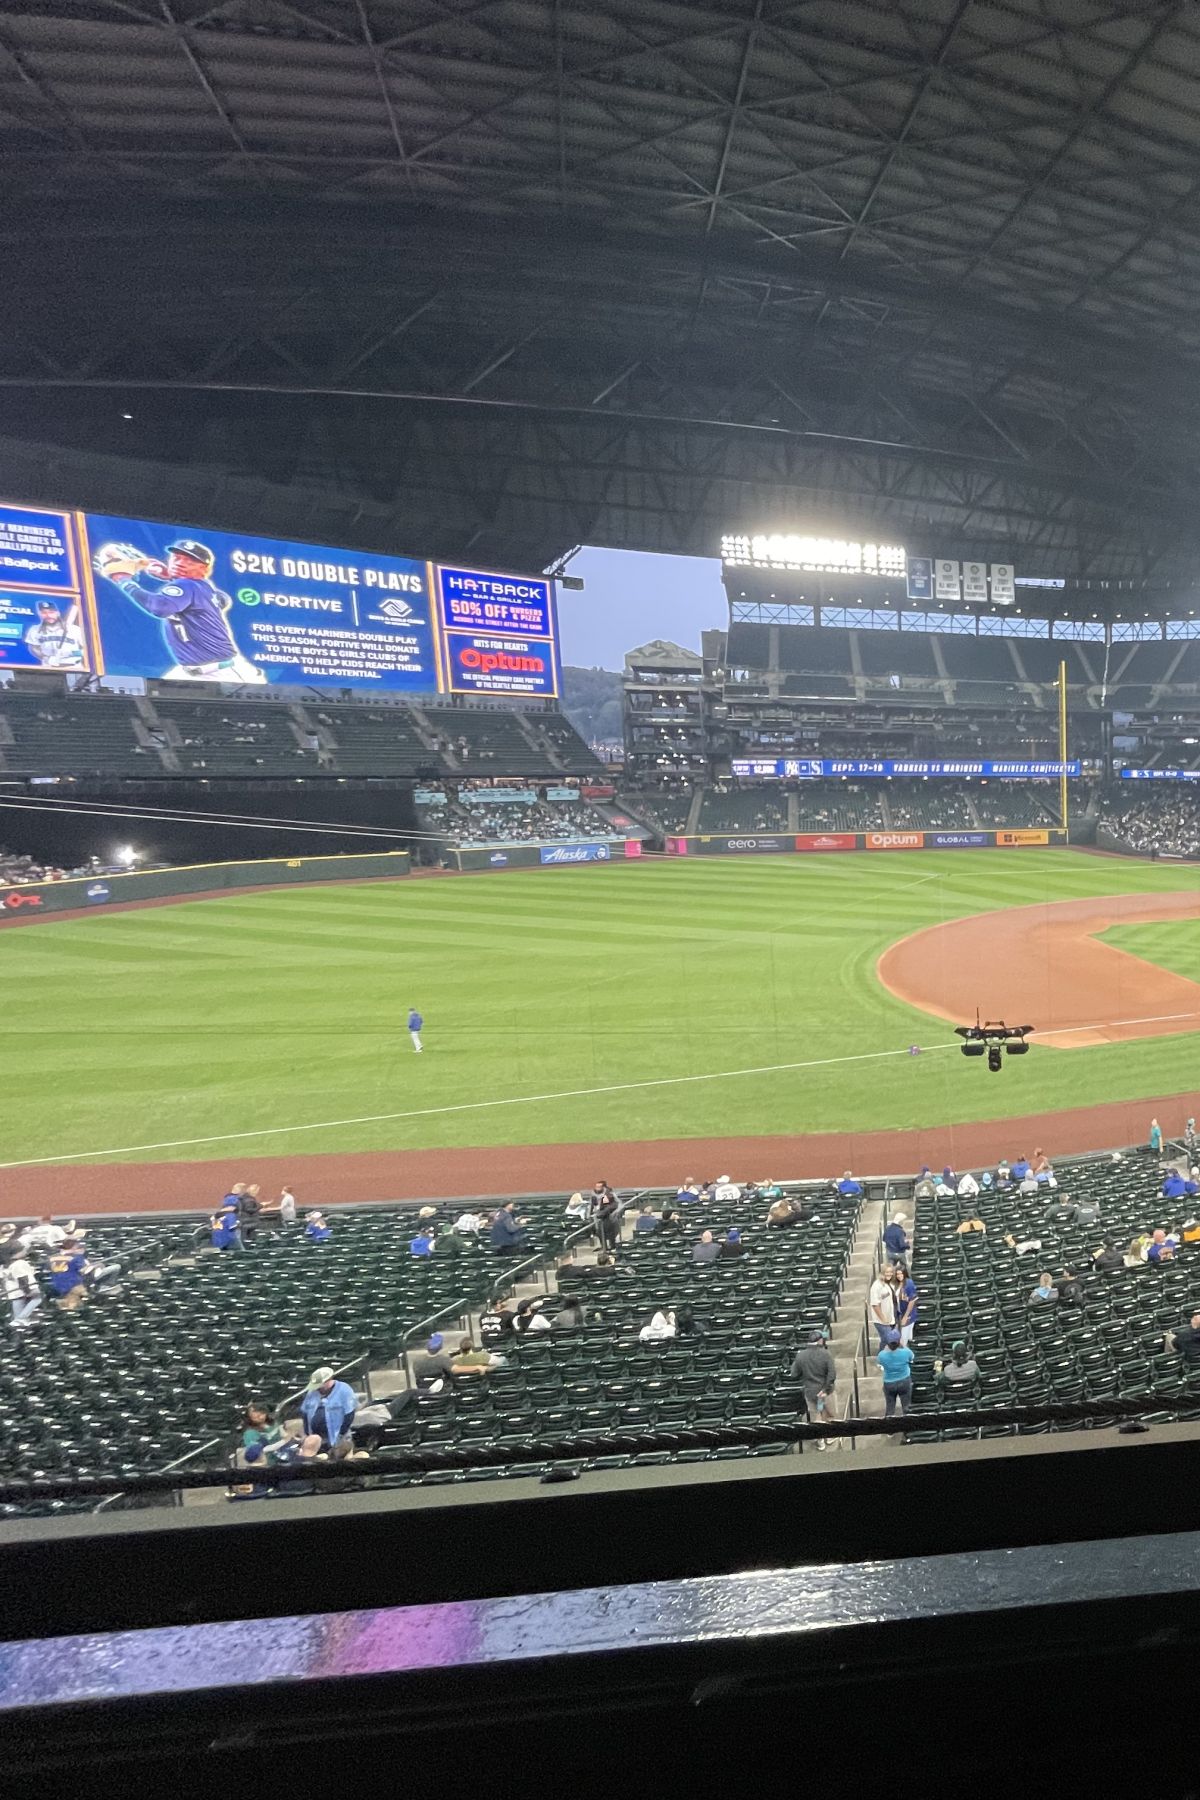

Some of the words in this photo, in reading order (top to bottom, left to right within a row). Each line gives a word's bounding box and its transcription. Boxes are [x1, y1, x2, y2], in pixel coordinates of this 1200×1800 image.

[4, 557, 61, 571] Ballpark
[232, 549, 277, 575] $2K
[282, 558, 360, 585] DOUBLE
[364, 569, 422, 593] PLAYS
[449, 576, 541, 600] HATBACK
[263, 592, 343, 613] FORTIVE
[450, 599, 481, 616] 50%
[484, 603, 508, 619] OFF
[520, 614, 542, 622] PIZZA
[252, 623, 274, 633] FOR
[275, 625, 307, 635] EVERY
[308, 628, 357, 640] MARINERS
[358, 632, 394, 643] DOUBLE
[395, 636, 418, 645] PLAY
[251, 633, 276, 642] THIS
[278, 635, 319, 647] SEASON,
[321, 639, 360, 650] FORTIVE
[361, 642, 384, 651] WILL
[385, 644, 420, 655] DONATE
[265, 644, 279, 653] TO
[282, 645, 301, 655] THE
[302, 647, 328, 657] BOYS
[329, 649, 338, 657] &
[338, 650, 366, 659] GIRLS
[367, 652, 397, 662] CLUBS
[397, 655, 411, 663] OF
[254, 653, 300, 664] AMERICA
[300, 656, 314, 665] TO
[315, 657, 340, 667] HELP
[341, 659, 364, 668] KIDS
[365, 661, 395, 671] REACH
[395, 663, 421, 673] THEIR
[460, 647, 545, 673] Optum
[303, 666, 328, 676] FULL
[329, 668, 382, 679] POTENTIAL.
[727, 839, 757, 849] eero
[871, 833, 918, 848] Optum
[936, 835, 969, 844] GLOBAL
[544, 848, 588, 861] Alaska
